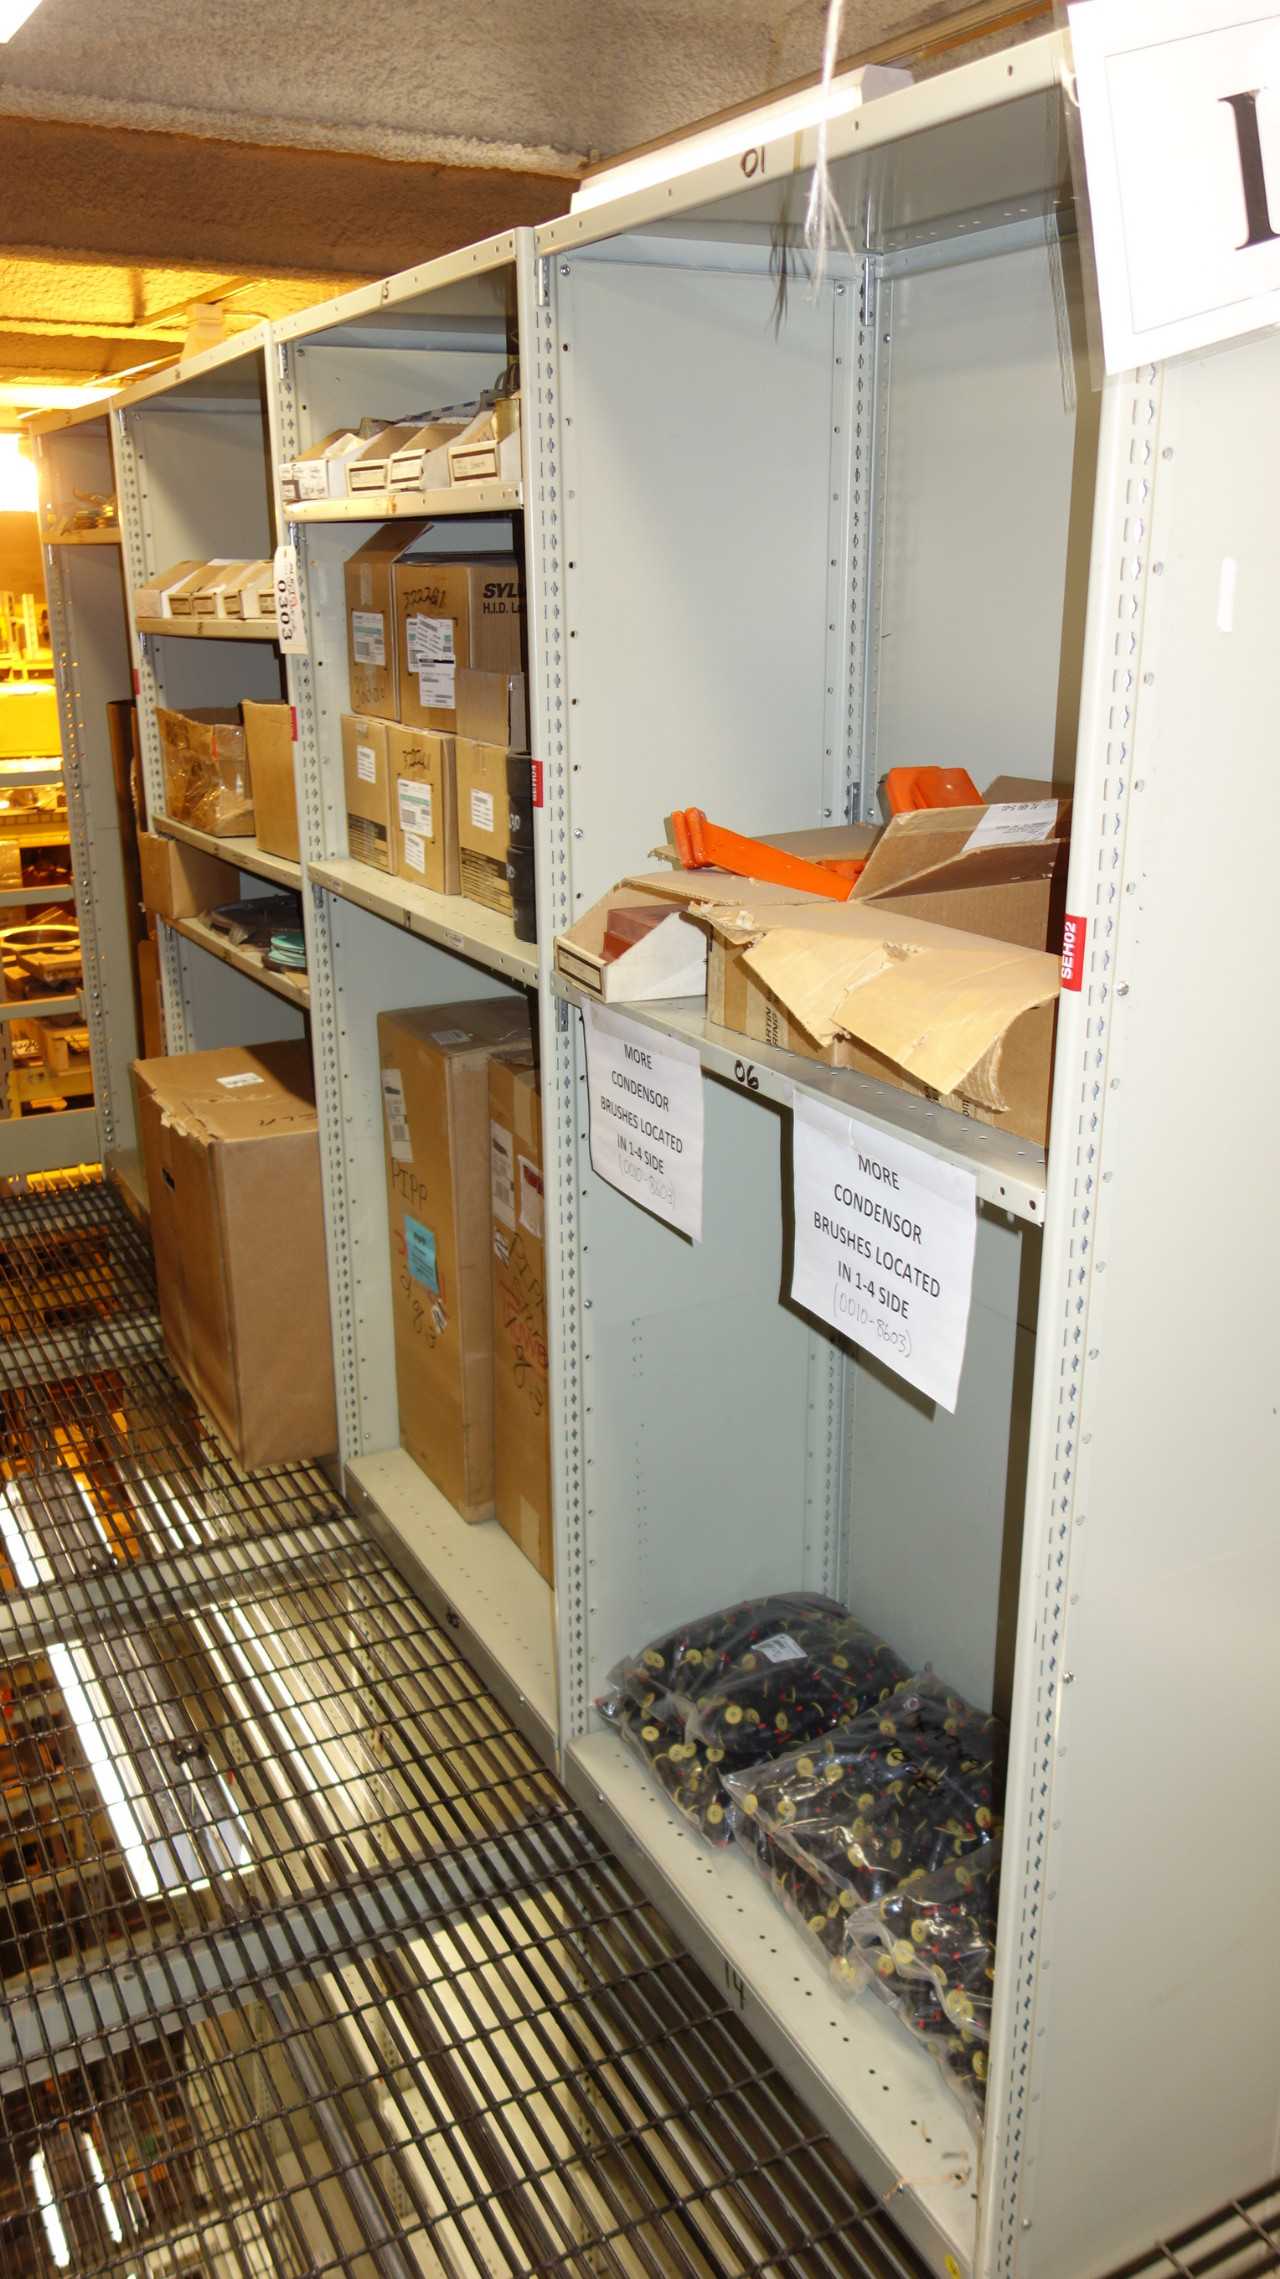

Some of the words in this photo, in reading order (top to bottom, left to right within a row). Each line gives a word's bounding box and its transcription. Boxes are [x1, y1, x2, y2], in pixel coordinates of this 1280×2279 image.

[1061, 921, 1077, 979] SEH02
[624, 1044, 653, 1070] MORE
[734, 1060, 759, 1090] 06
[611, 1070, 670, 1112] CONDENSOR
[600, 1095, 638, 1130] BRUSHES
[640, 1120, 683, 1153] LOCATED
[617, 1133, 627, 1151] IN
[629, 1141, 643, 1160] 1-4
[644, 1152, 665, 1175] SIDE
[857, 1153, 900, 1190] MORE
[833, 1183, 922, 1245] CONDENSOR
[813, 1211, 872, 1259] BRUSHES
[875, 1246, 941, 1298] LOCATED
[838, 1260, 851, 1283] IN
[855, 1272, 875, 1298] 1-4
[878, 1286, 910, 1319] SIDE
